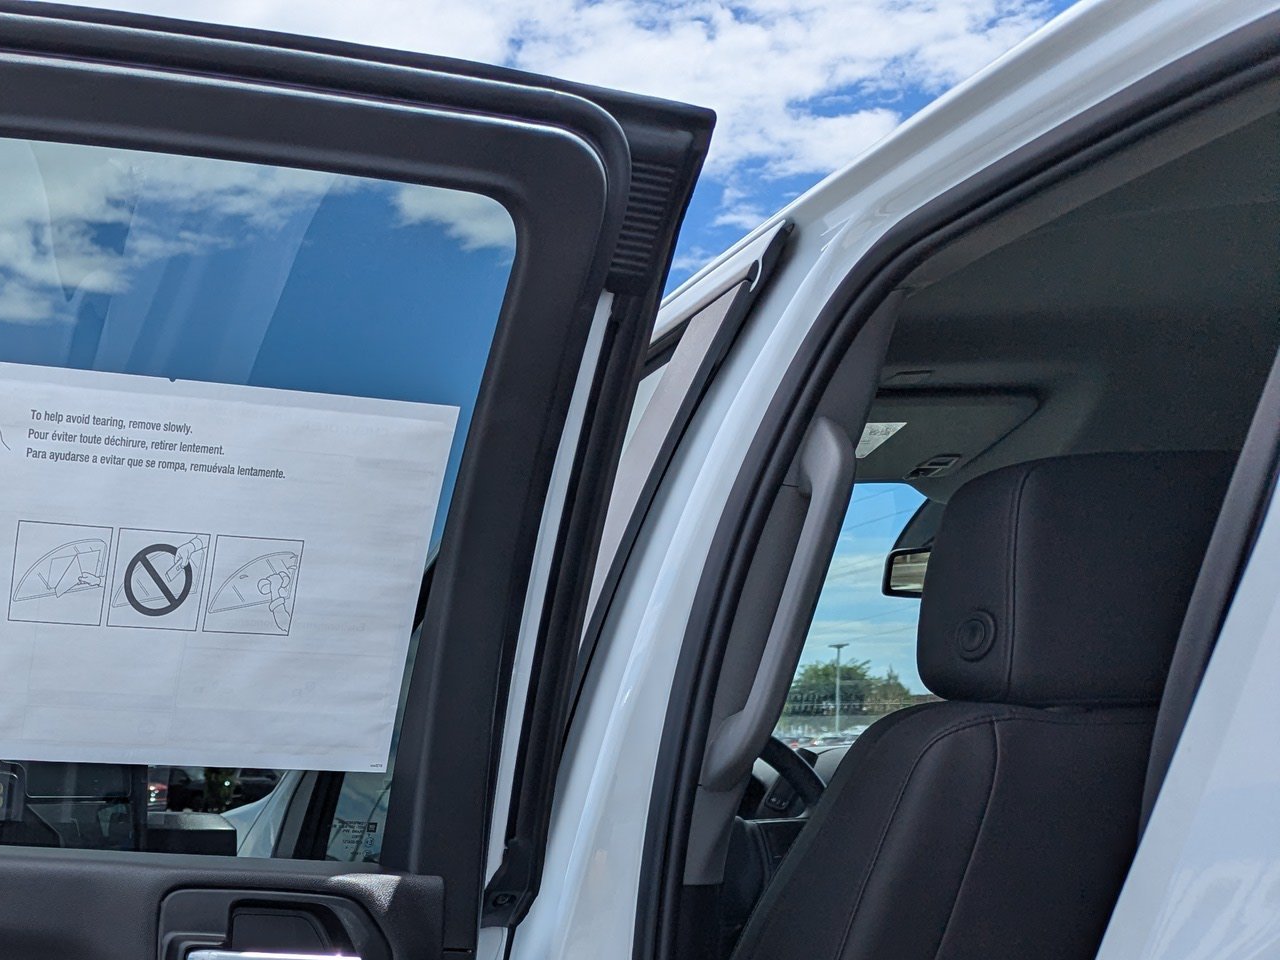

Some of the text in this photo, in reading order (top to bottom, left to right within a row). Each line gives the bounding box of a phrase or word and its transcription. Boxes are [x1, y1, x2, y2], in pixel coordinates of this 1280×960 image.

[30, 409, 193, 436] To help avoid tearing, remove slowly.
[27, 428, 225, 455] Pour éviter toute déchirure, retirer lentement.
[26, 447, 286, 479] Para ayudarse a evitar que se rompa, remuévala lentamente.
